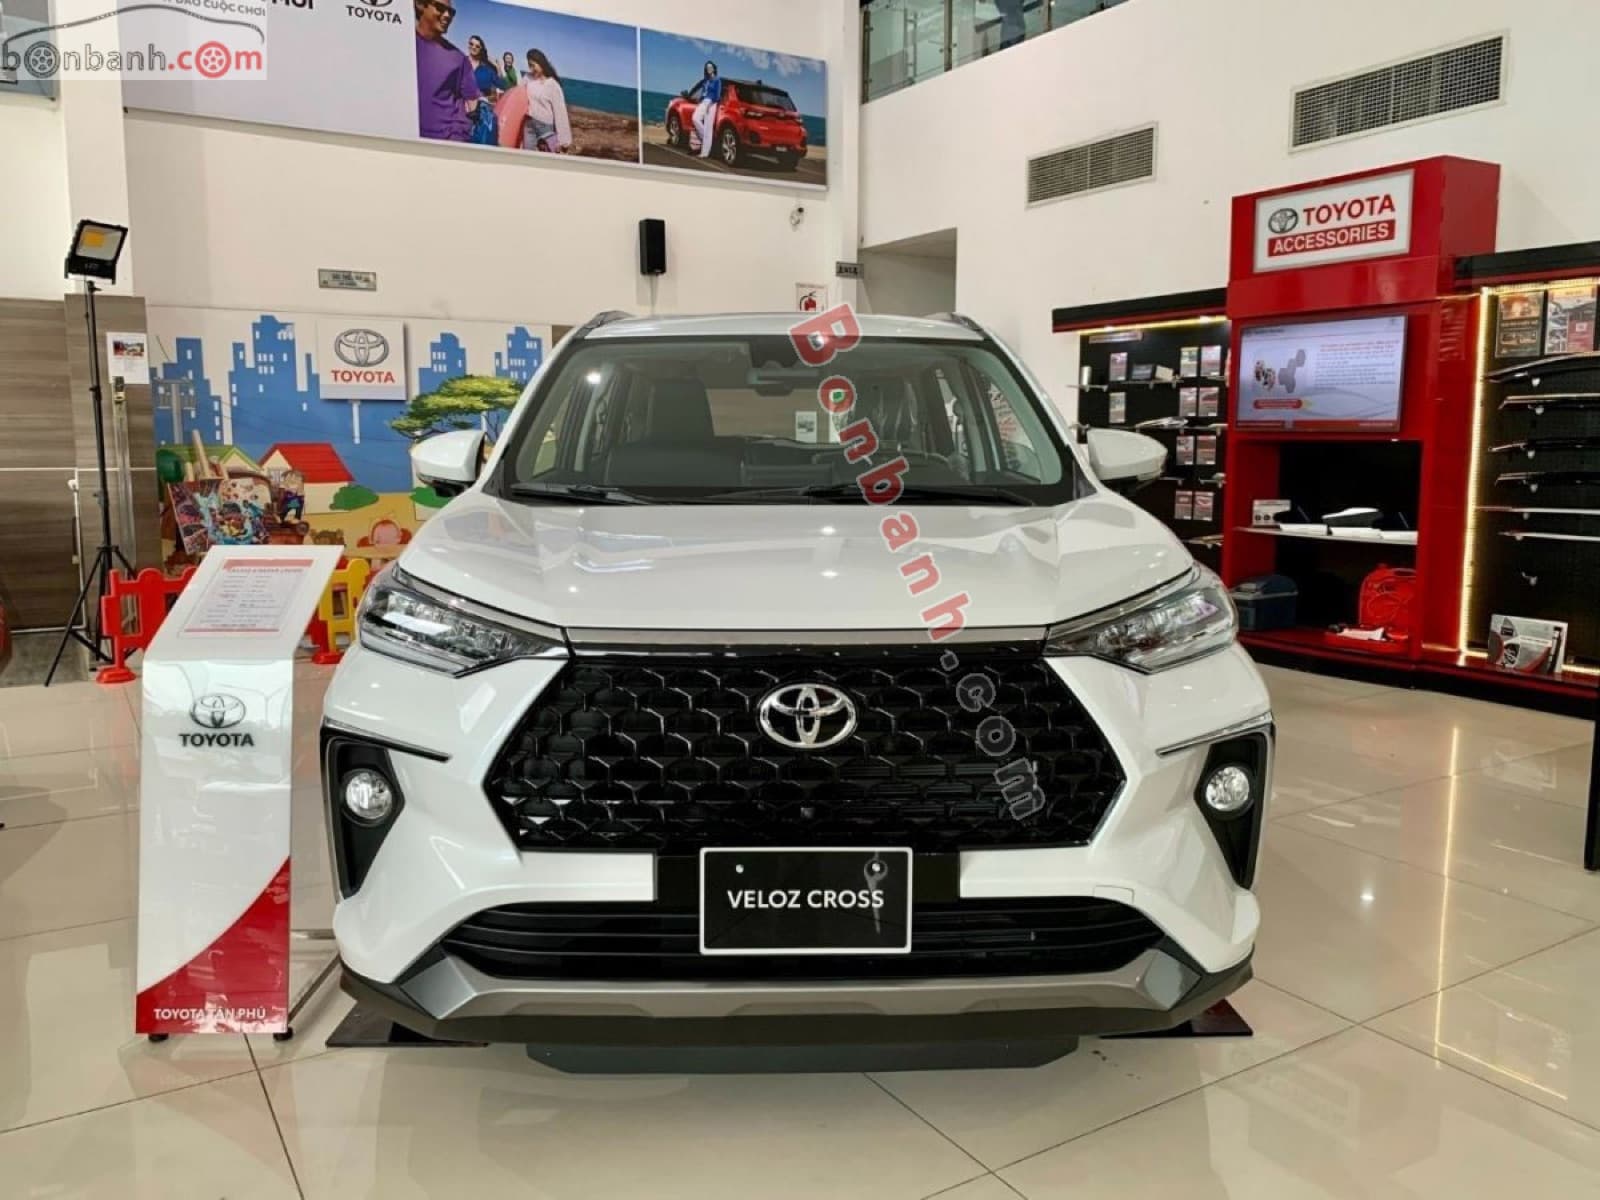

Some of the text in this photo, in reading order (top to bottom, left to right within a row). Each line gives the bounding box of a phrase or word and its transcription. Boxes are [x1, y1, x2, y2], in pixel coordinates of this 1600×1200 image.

[345, 5, 402, 24] TOYOTA
[1303, 194, 1395, 226] TOYOTA
[1273, 222, 1389, 254] ACCESSORIES
[331, 370, 395, 383] TOYOTA
[178, 733, 254, 747] TOYOTA
[727, 889, 884, 909] VELOZ CROSS
[153, 1008, 204, 1020] TOYOTA
